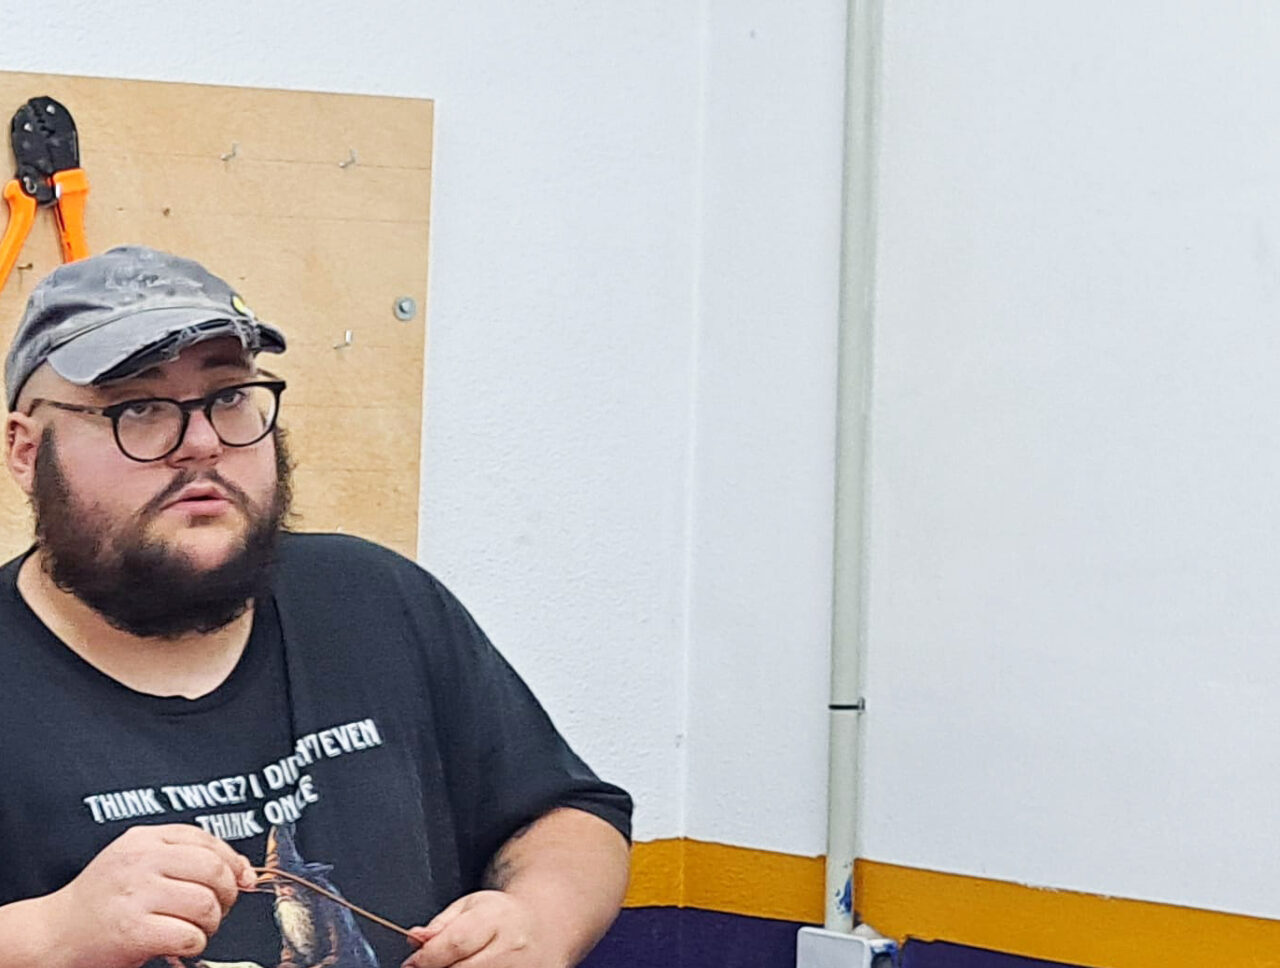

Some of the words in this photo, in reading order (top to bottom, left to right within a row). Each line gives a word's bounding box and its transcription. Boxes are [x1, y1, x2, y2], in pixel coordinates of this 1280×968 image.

[84, 787, 165, 824] THINK
[161, 776, 247, 812] TWICE?
[248, 773, 265, 799] I
[318, 718, 383, 758] EVEN
[195, 809, 265, 841] THINK
